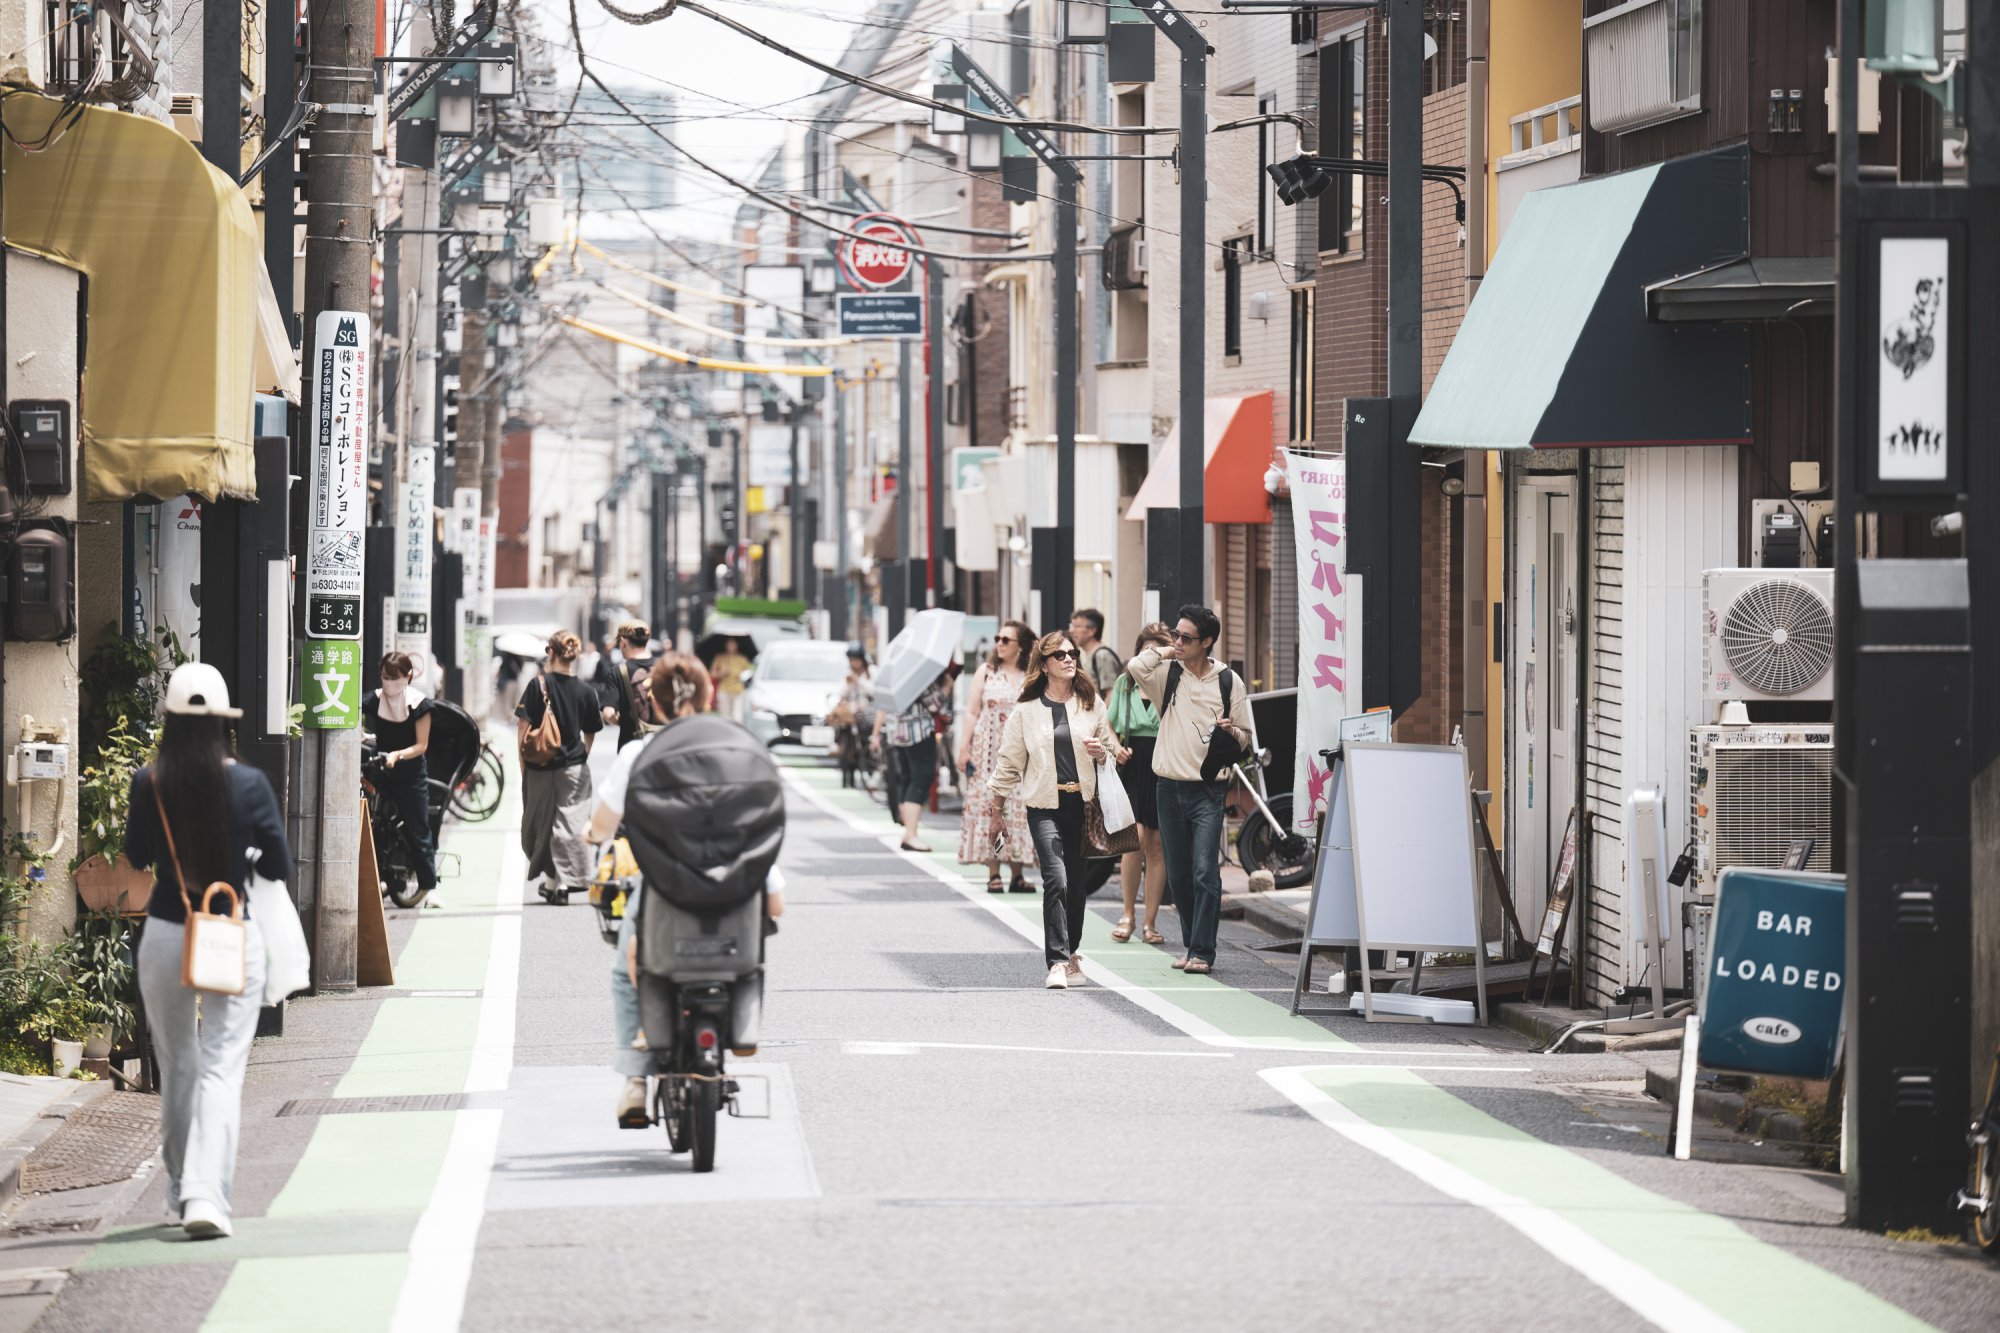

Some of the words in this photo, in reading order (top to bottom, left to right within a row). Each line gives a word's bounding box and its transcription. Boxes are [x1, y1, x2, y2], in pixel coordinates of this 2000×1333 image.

[338, 329, 356, 343] SG
[320, 351, 333, 444] おウチの事でお困りの事
[318, 447, 329, 525] 何でも相談に乗ります
[319, 603, 354, 616] 北沢
[319, 618, 352, 631] 3-34
[311, 650, 353, 665] 通学路
[317, 715, 345, 725] 世田谷区
[1756, 910, 1812, 937] BAR
[1716, 956, 1841, 992] LOADED
[1755, 1021, 1790, 1038] cafe
